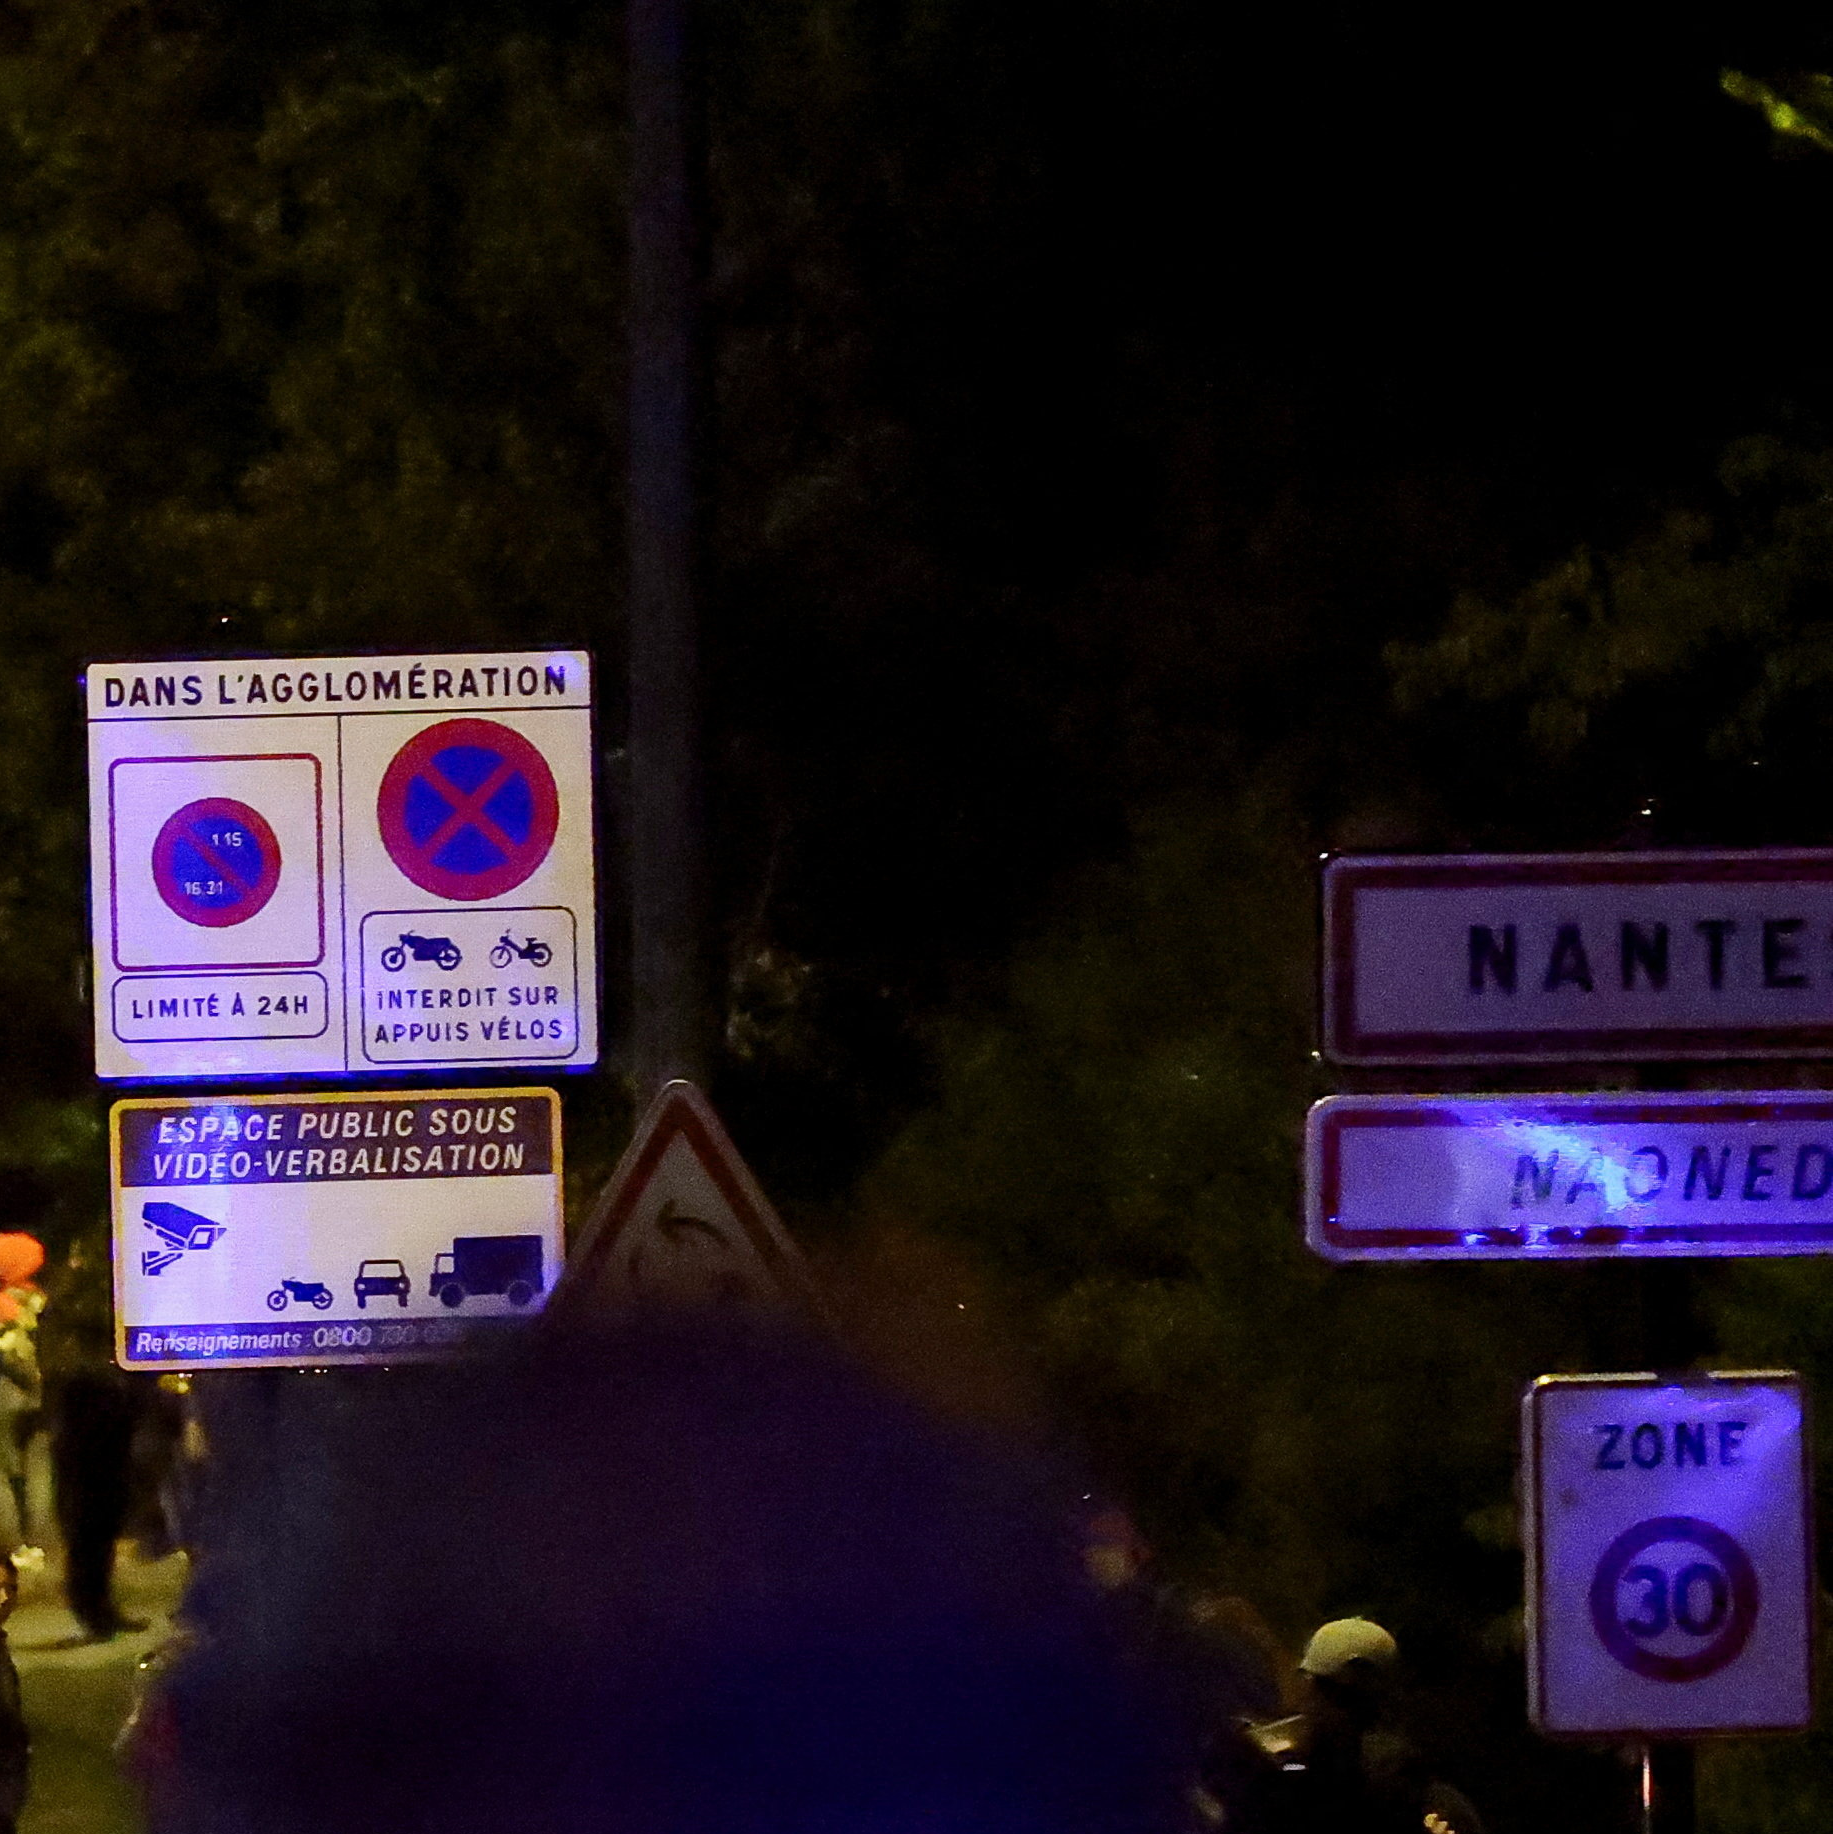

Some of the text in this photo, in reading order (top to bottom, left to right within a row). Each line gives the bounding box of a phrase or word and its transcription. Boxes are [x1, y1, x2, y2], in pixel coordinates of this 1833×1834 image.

[105, 663, 566, 707] DANS L'AGGLOMÉRATION
[1468, 919, 1833, 994] NANTE
[132, 992, 308, 1019] LIMITÉ À 24H
[377, 985, 559, 1010] INTERDIT SUR
[375, 1015, 563, 1044] APPUIS VÉLOS
[157, 1105, 518, 1145] ESPACE PUBLIC SOUS
[153, 1142, 525, 1181] VIDÉO-VERBALISATION
[136, 1331, 303, 1357] Renseignements
[314, 1326, 372, 1348] 0800
[1595, 1421, 1747, 1470] ZONE
[1621, 1562, 1729, 1638] 30
